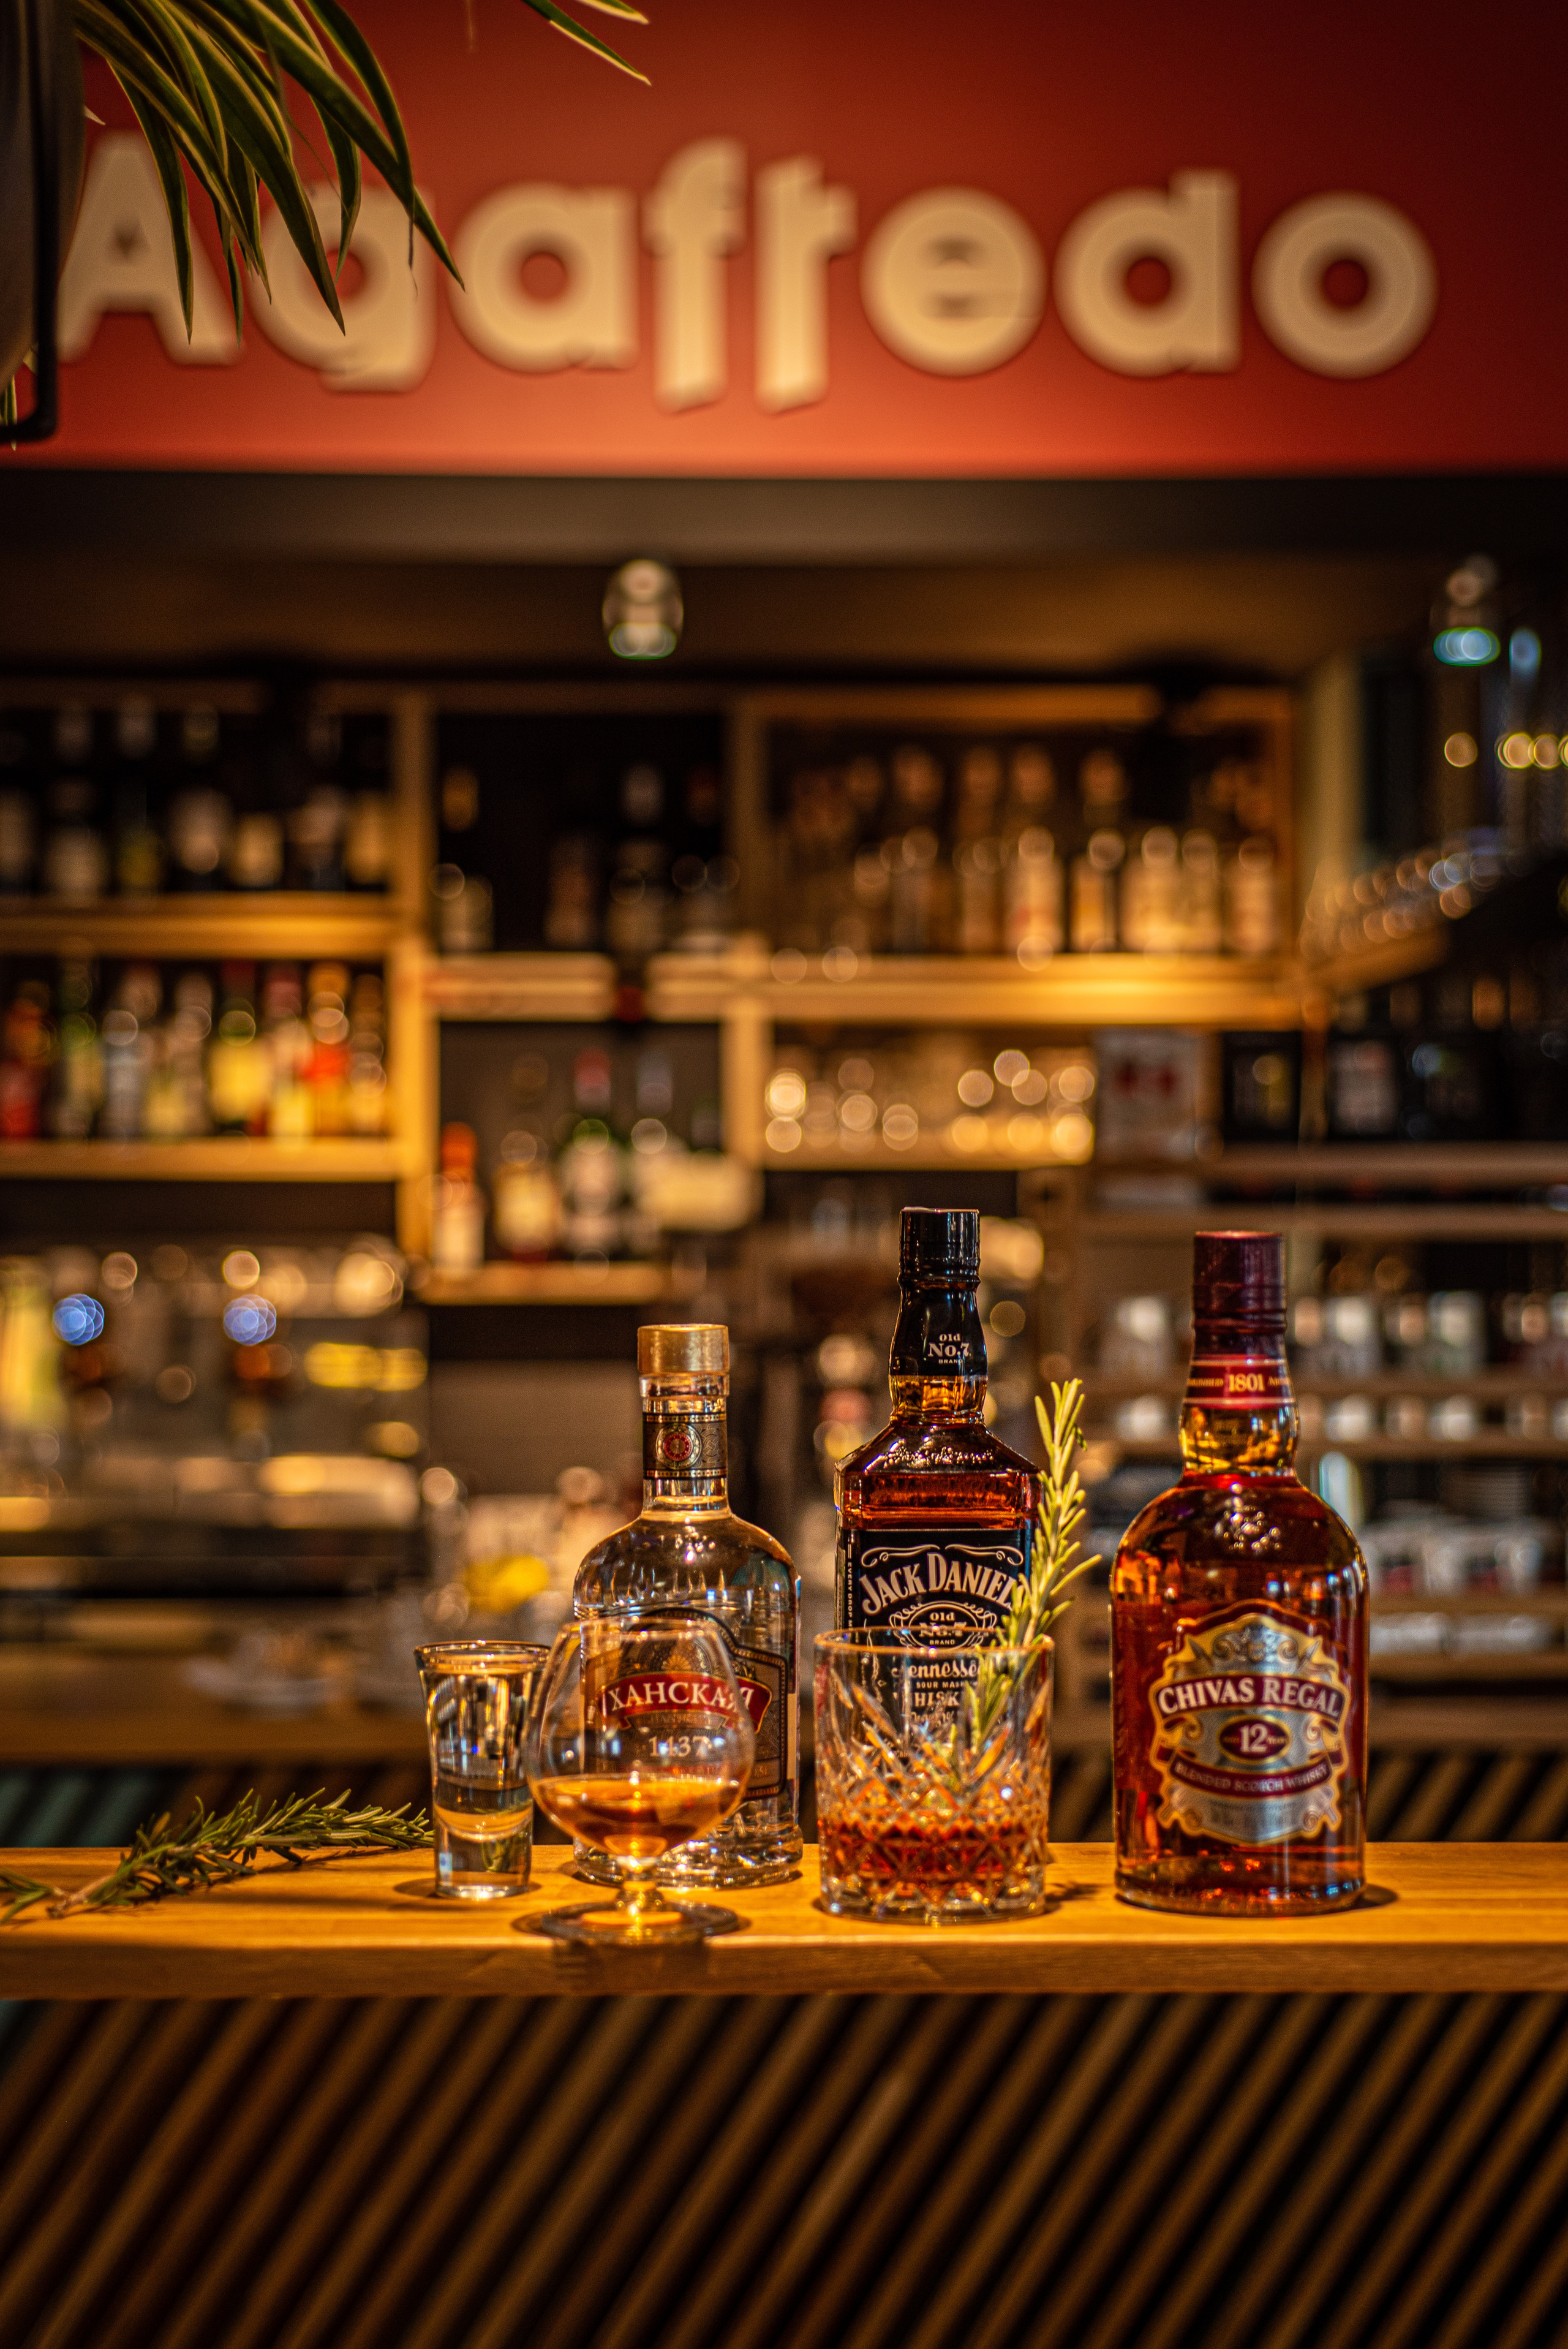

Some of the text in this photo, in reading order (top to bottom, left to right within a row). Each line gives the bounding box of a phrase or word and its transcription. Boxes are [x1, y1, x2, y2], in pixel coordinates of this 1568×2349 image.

[939, 1333, 961, 1342] Old
[1229, 1373, 1265, 1392] 1801
[859, 1563, 925, 1614] JACK
[927, 1552, 1016, 1612] DANIEL
[930, 1612, 955, 1621] Old
[891, 1659, 981, 1678] ennesse
[1158, 1678, 1340, 1717] CHIVAS REGAL
[1240, 1723, 1268, 1753] 12
[1235, 1779, 1284, 1792] SCOTCH
[1286, 1762, 1327, 1787] WHISKY
